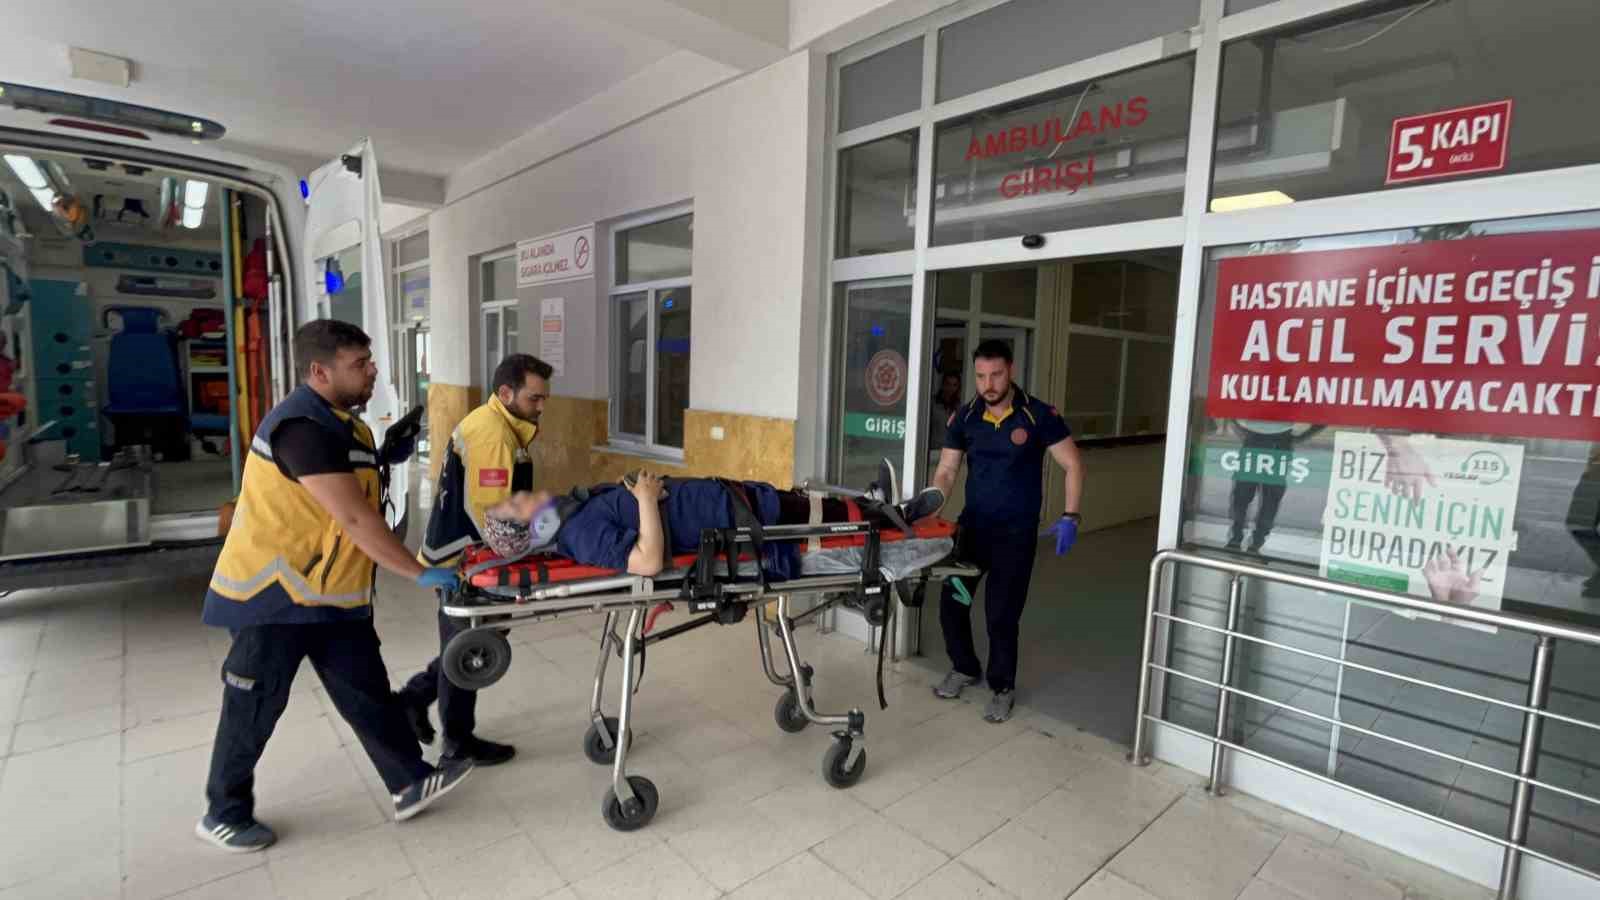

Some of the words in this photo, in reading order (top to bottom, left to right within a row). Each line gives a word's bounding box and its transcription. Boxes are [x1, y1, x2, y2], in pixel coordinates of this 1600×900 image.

[964, 96, 1150, 161] AMBULANS
[1395, 126, 1434, 172] 5.
[1431, 113, 1501, 151] KAPI
[1000, 154, 1097, 198] GİRİŞİ
[1230, 278, 1358, 311] HASTANE
[1365, 267, 1456, 313] İÇİNE
[1465, 258, 1576, 309] GEÇİŞ
[1240, 318, 1355, 363] ACİL
[1382, 313, 1600, 366] SERVİ
[865, 417, 906, 439] GİRİŞ
[1220, 450, 1310, 483] GİRİŞ
[1339, 446, 1386, 483] BİZ
[1472, 459, 1499, 472] 115
[1434, 494, 1505, 540] İÇİN
